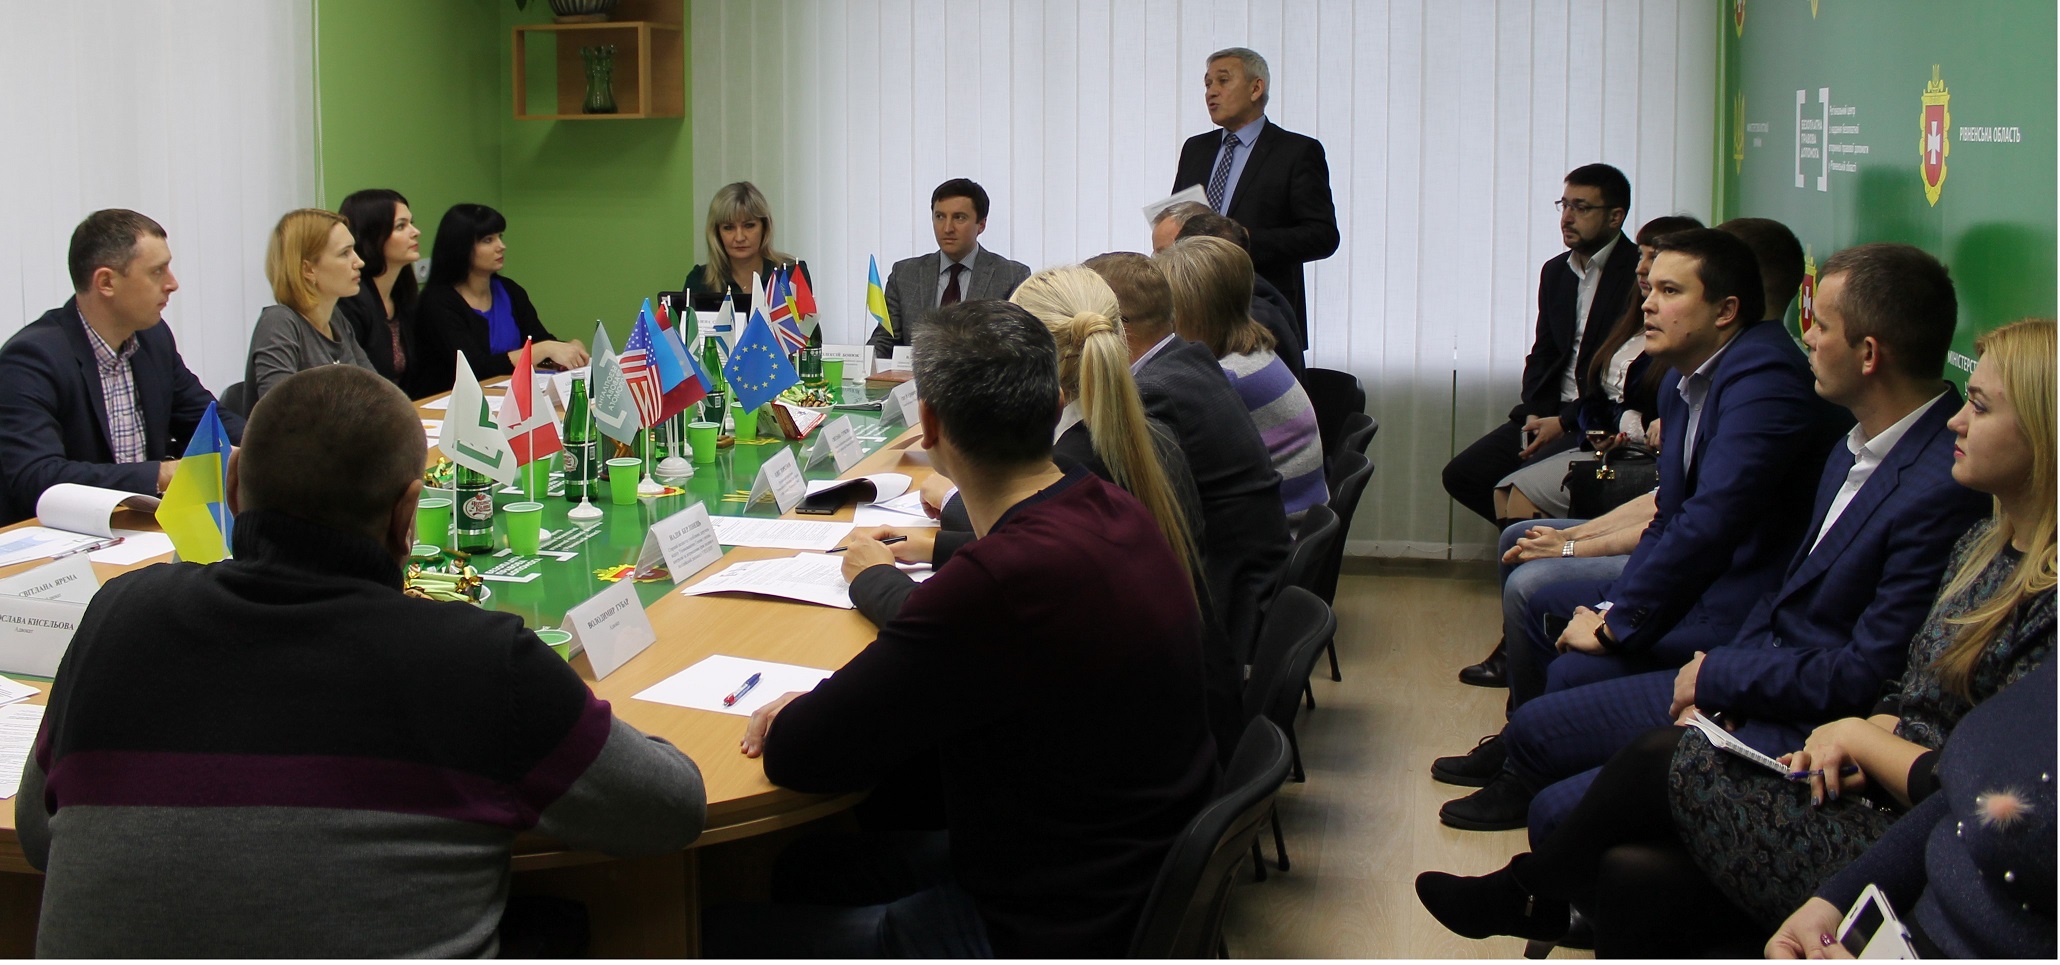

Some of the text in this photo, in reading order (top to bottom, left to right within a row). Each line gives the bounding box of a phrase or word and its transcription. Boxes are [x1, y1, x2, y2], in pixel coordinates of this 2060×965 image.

[1960, 126, 2020, 143] РІВНЕНСЬКА ОБЛАСТЬ
[1948, 351, 1977, 373] МІНІСТЕРСТ
[19, 583, 53, 597] СВІТЛАНА
[54, 574, 78, 587] ЯРЕМА
[27, 617, 74, 631] КИСЕЛЬОВА
